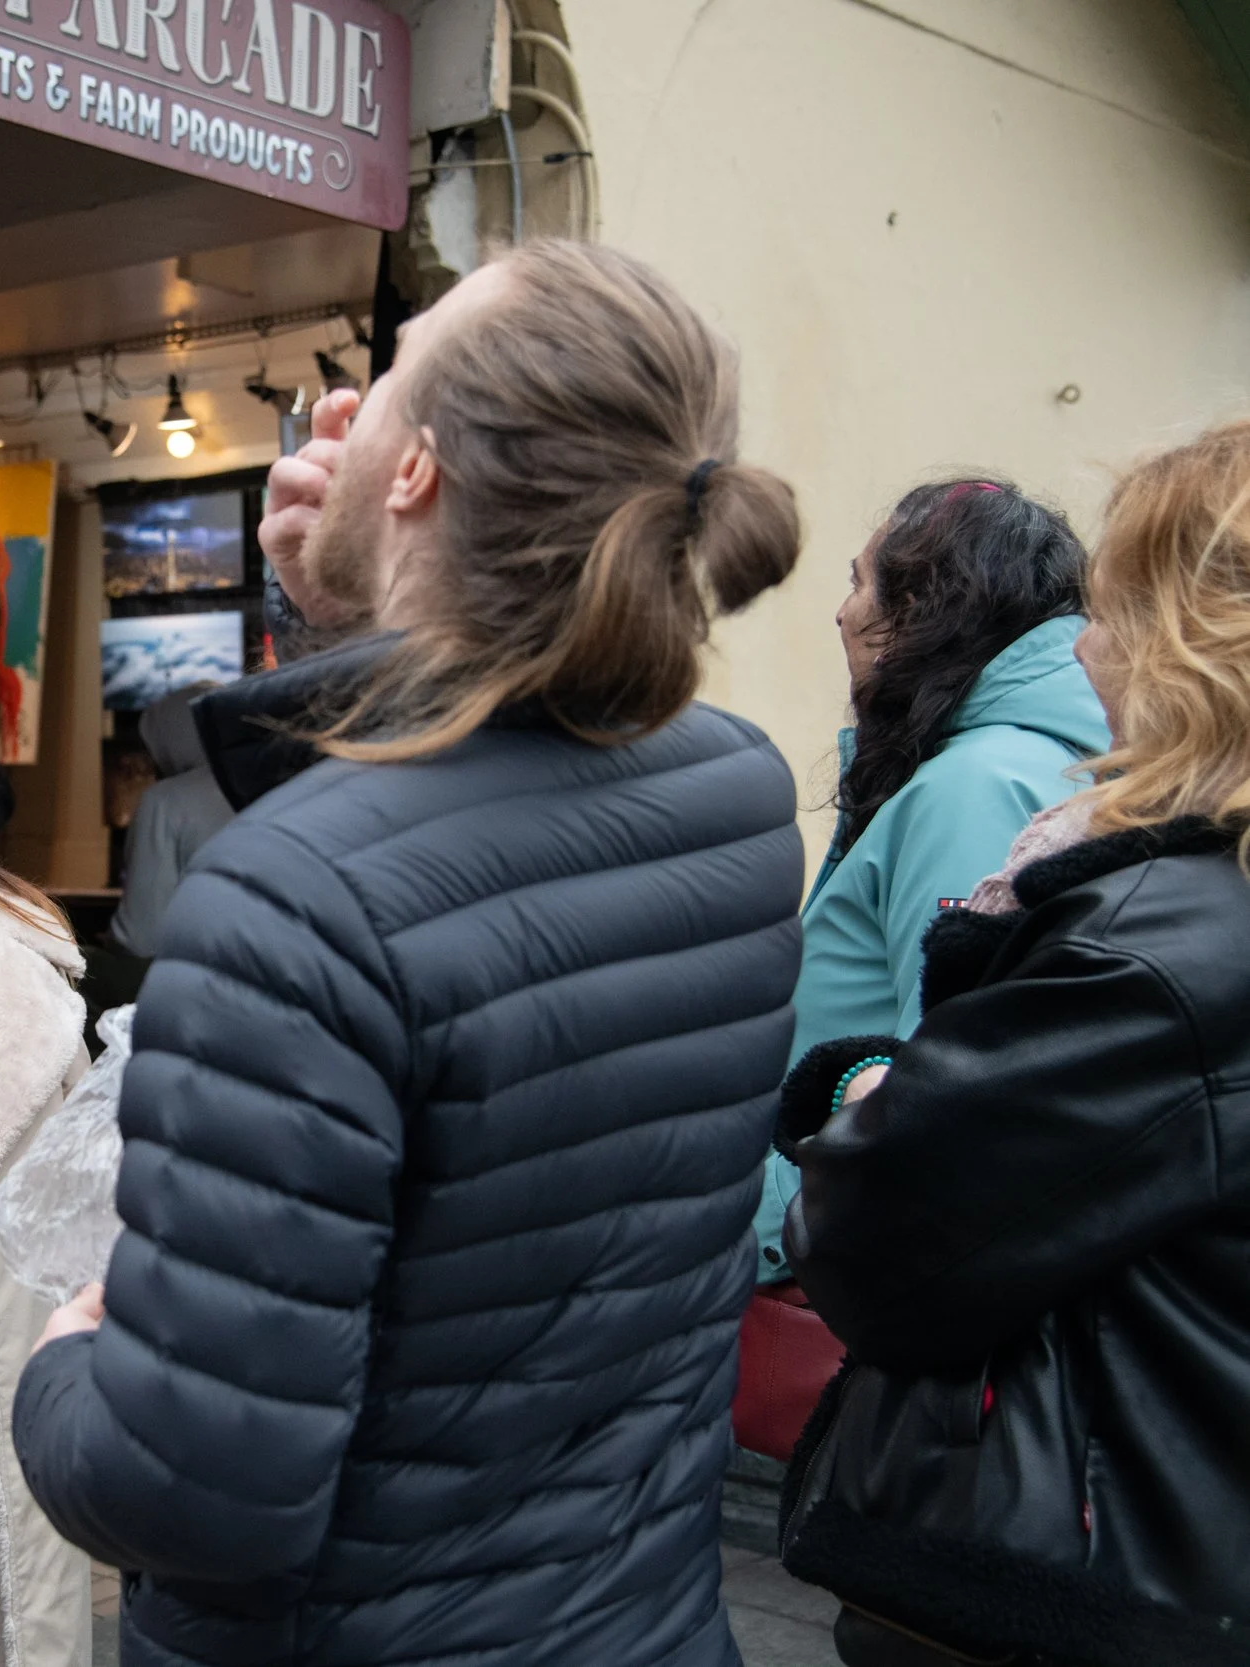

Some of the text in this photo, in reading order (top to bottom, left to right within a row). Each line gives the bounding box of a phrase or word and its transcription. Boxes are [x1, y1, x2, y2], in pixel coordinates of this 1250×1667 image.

[45, 63, 71, 111] &
[79, 74, 162, 141] FARM
[170, 103, 314, 185] PRODUCTS
